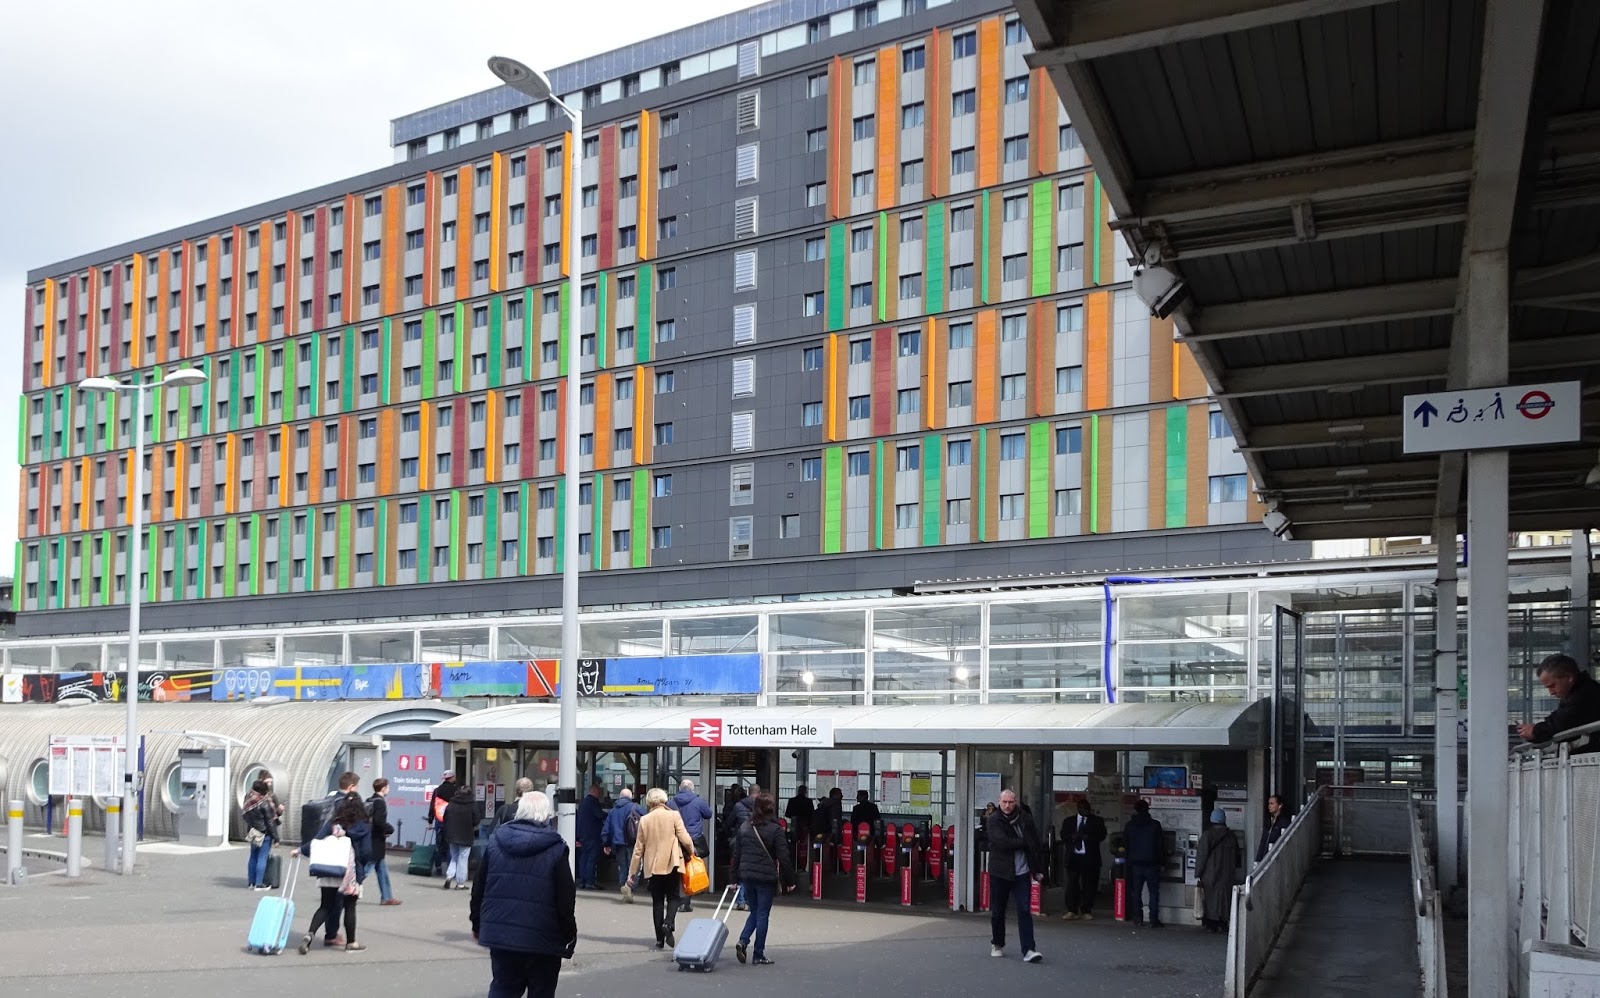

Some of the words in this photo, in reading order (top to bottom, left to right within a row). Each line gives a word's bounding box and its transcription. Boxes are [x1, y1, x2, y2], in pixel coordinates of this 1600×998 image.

[727, 724, 787, 736] Tottenham
[791, 724, 817, 736] Hale
[393, 776, 405, 784] Train
[405, 776, 421, 784] tickets
[421, 777, 431, 785] and
[398, 784, 425, 792] information
